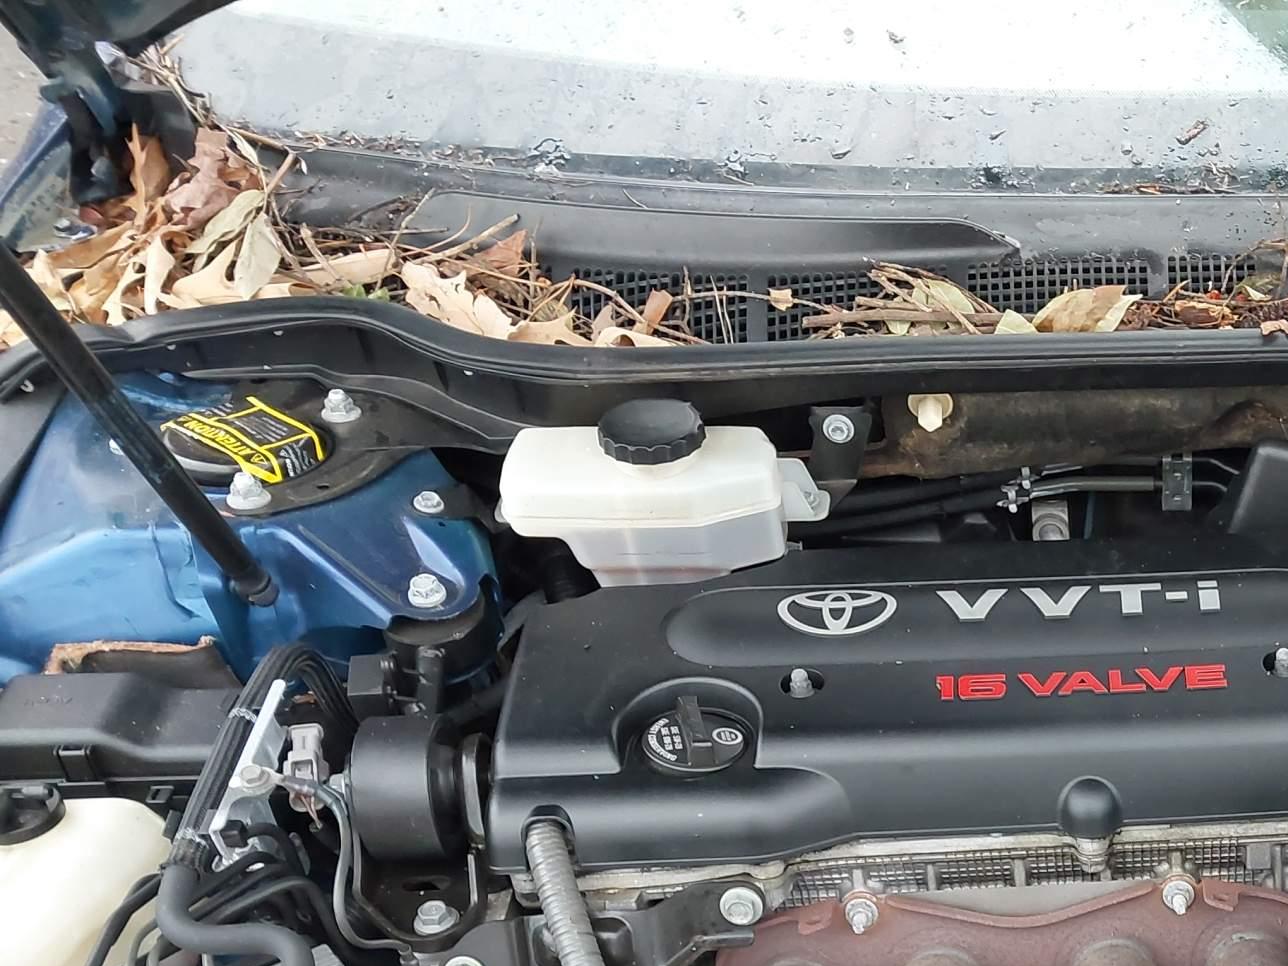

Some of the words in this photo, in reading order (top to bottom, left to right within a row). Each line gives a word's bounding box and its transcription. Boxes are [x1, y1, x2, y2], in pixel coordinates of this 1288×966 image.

[184, 419, 258, 455] ATTENTION
[935, 580, 1221, 622] VVT-i
[936, 673, 1007, 701] 16
[1018, 664, 1228, 697] VALVE
